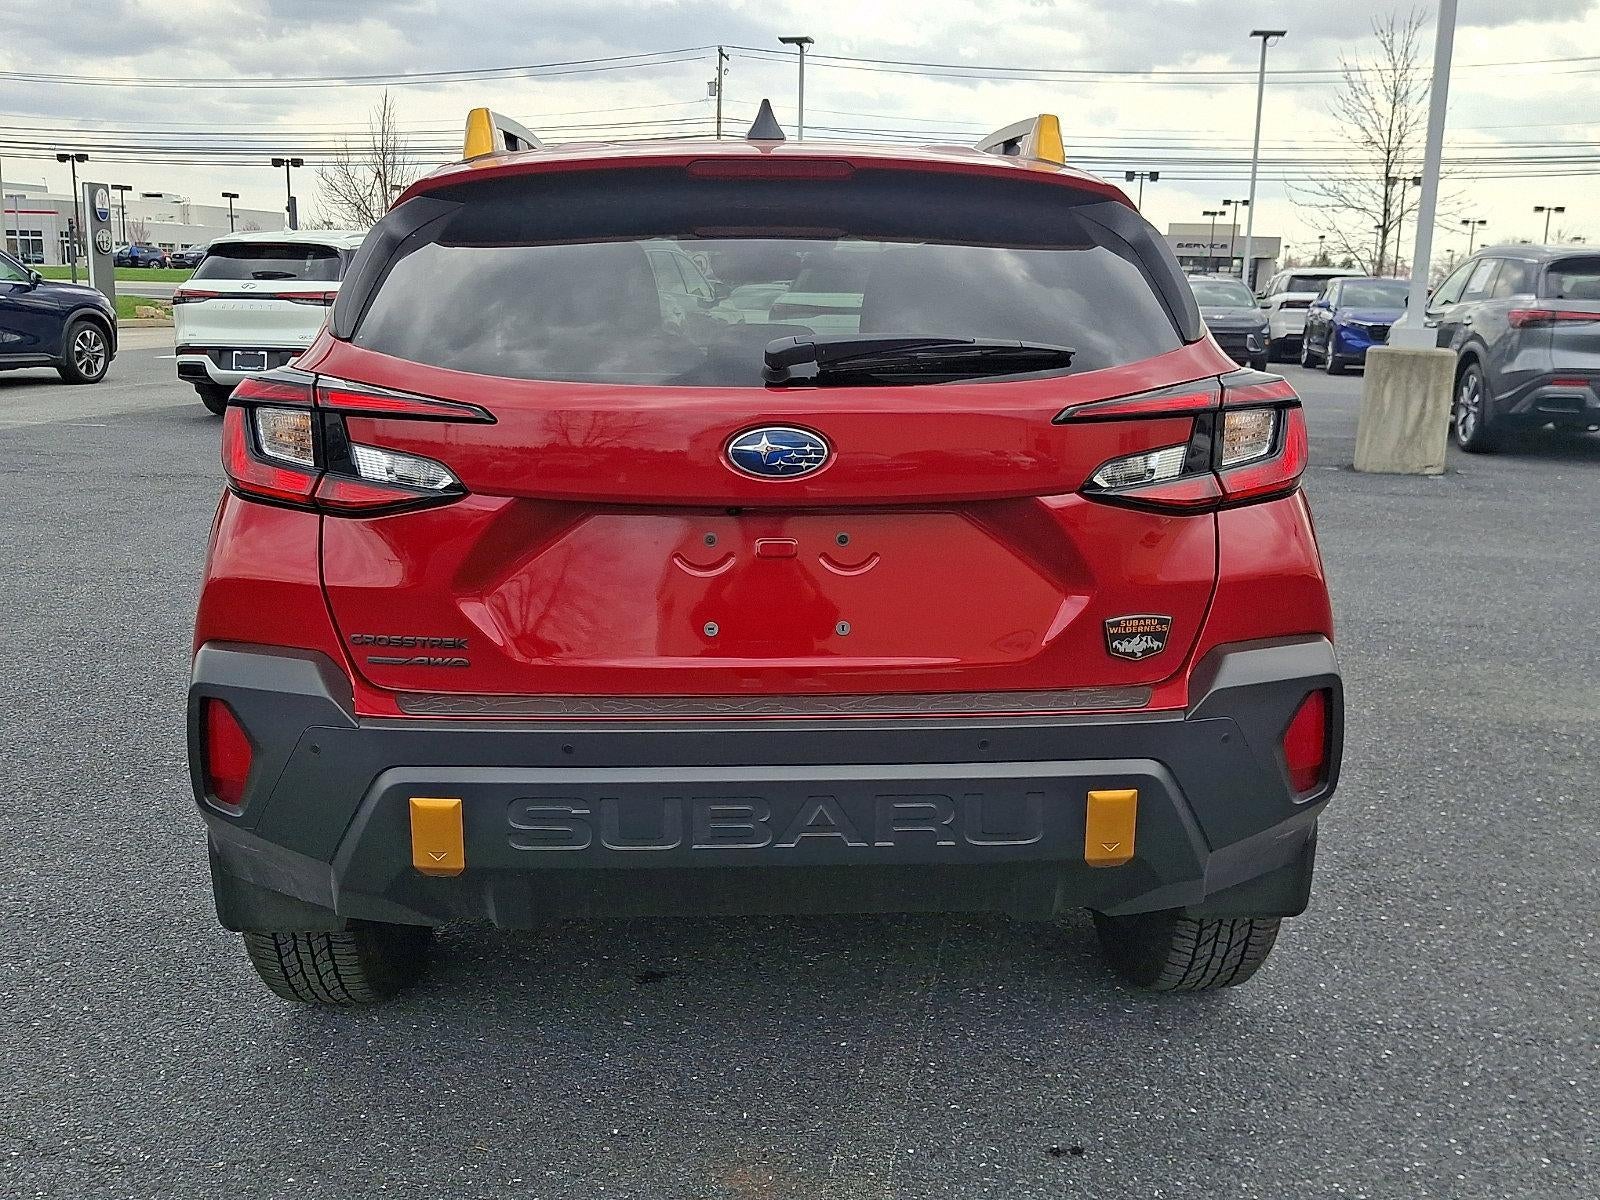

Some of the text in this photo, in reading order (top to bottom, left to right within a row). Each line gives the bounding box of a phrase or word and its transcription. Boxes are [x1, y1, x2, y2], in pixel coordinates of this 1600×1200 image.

[1120, 618, 1158, 627] SUBARU
[1109, 624, 1169, 634] WILDERNESS
[349, 633, 469, 650] CROSSTREK
[408, 657, 471, 668] AWD
[506, 791, 1046, 851] SUBARU
